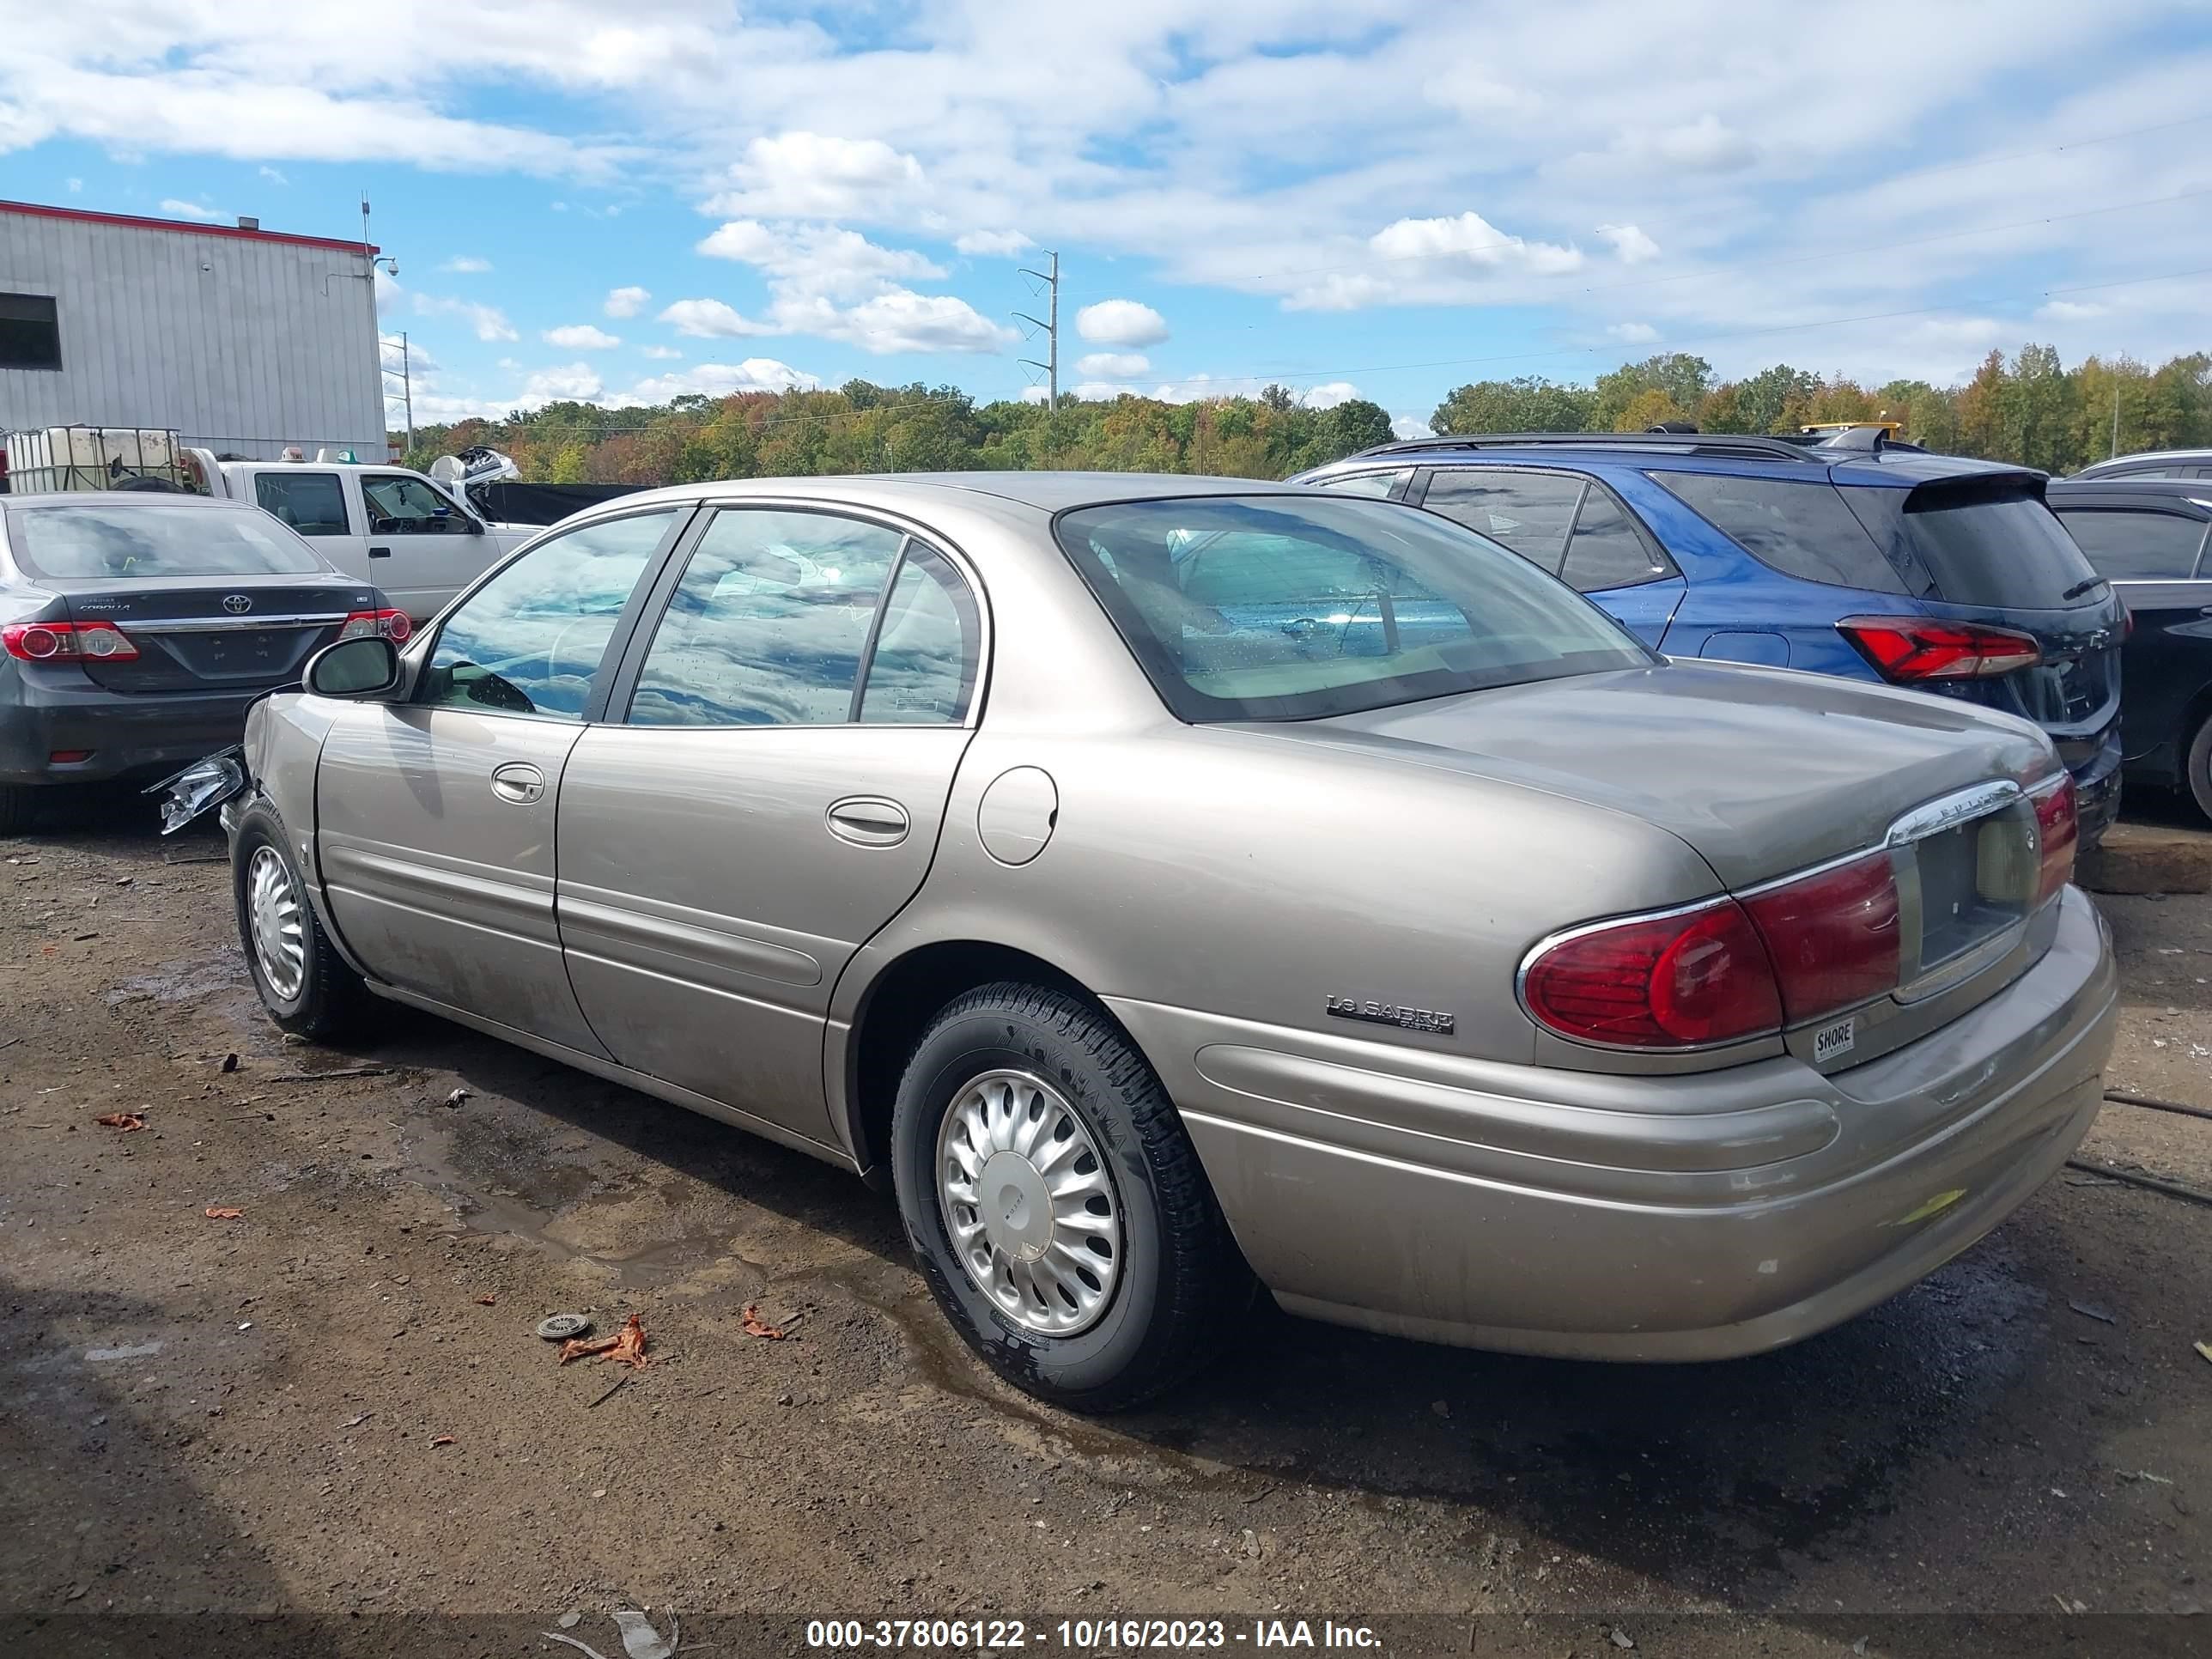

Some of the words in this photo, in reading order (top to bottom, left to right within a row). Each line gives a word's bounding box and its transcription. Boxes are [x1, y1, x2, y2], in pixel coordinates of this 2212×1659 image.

[1363, 1000, 1454, 1027] SABRE
[1817, 1023, 1851, 1052] SHORE
[1024, 1033, 1127, 1155] YOKOHAMA
